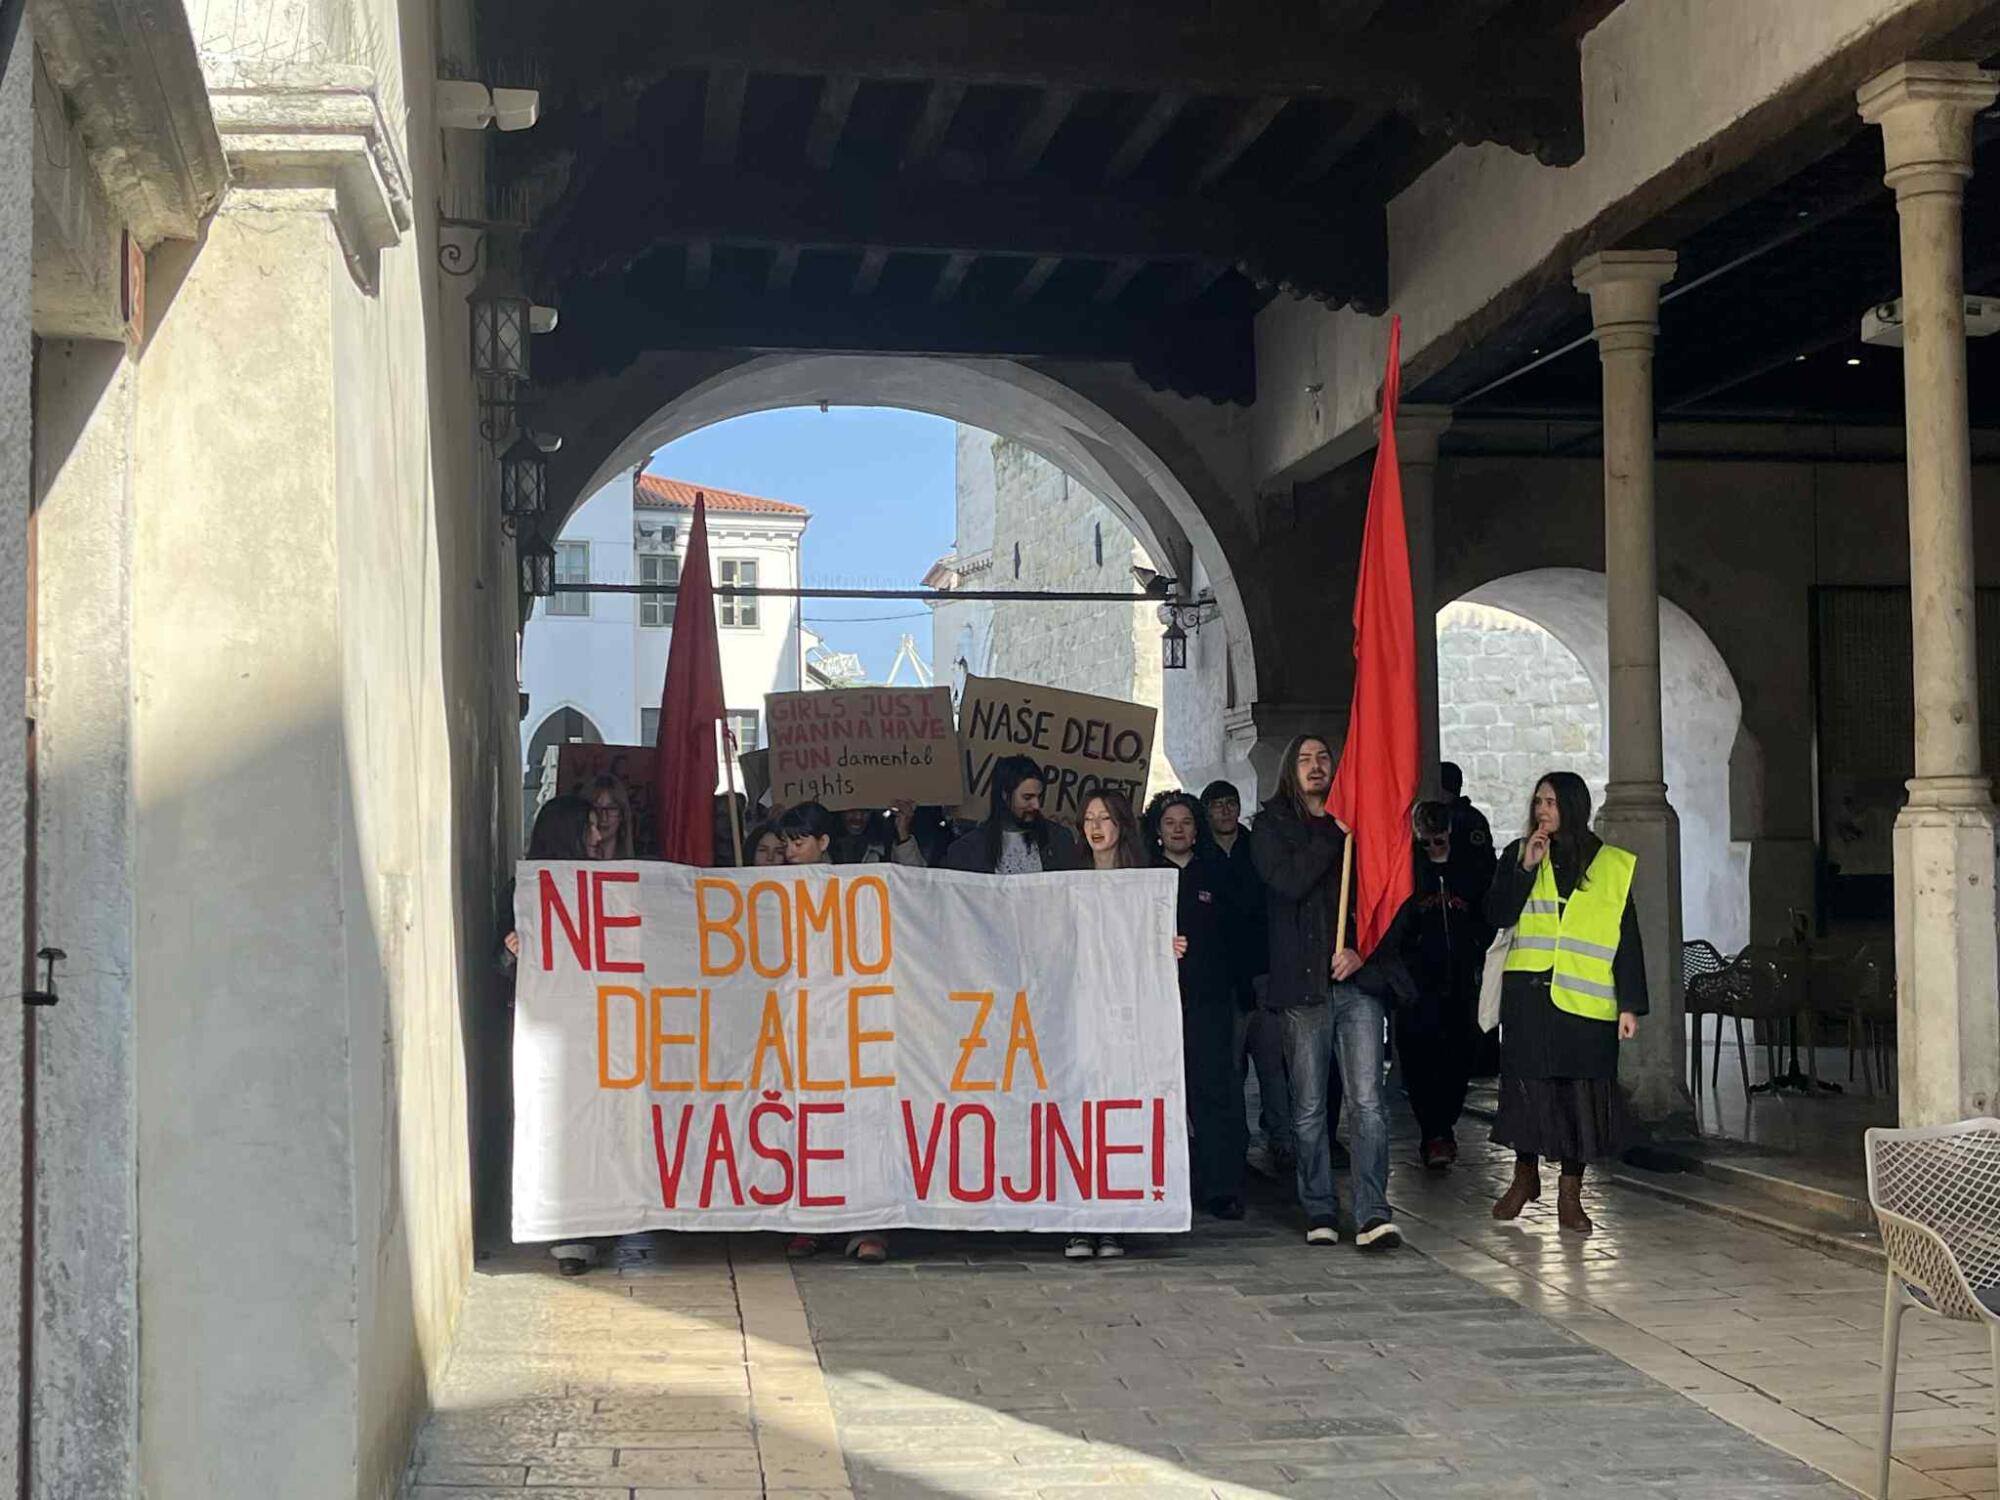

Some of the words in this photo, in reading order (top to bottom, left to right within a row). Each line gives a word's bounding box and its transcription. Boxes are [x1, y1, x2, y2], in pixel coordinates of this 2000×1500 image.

[772, 695, 846, 721] GIRLS
[863, 692, 936, 717] JUST
[775, 720, 874, 746] WANNA
[880, 719, 948, 740] HAVE
[969, 698, 1055, 750] NAŠE
[1060, 717, 1148, 770] DELO,
[784, 774, 855, 802] rights
[1039, 764, 1143, 813] PROT
[540, 871, 644, 972] NE
[696, 877, 891, 977] BOMO
[598, 986, 894, 1091] DELALE
[951, 990, 1046, 1090] ZA
[653, 1091, 844, 1208] VAŠE
[902, 1099, 1164, 1204] VOJNE!
